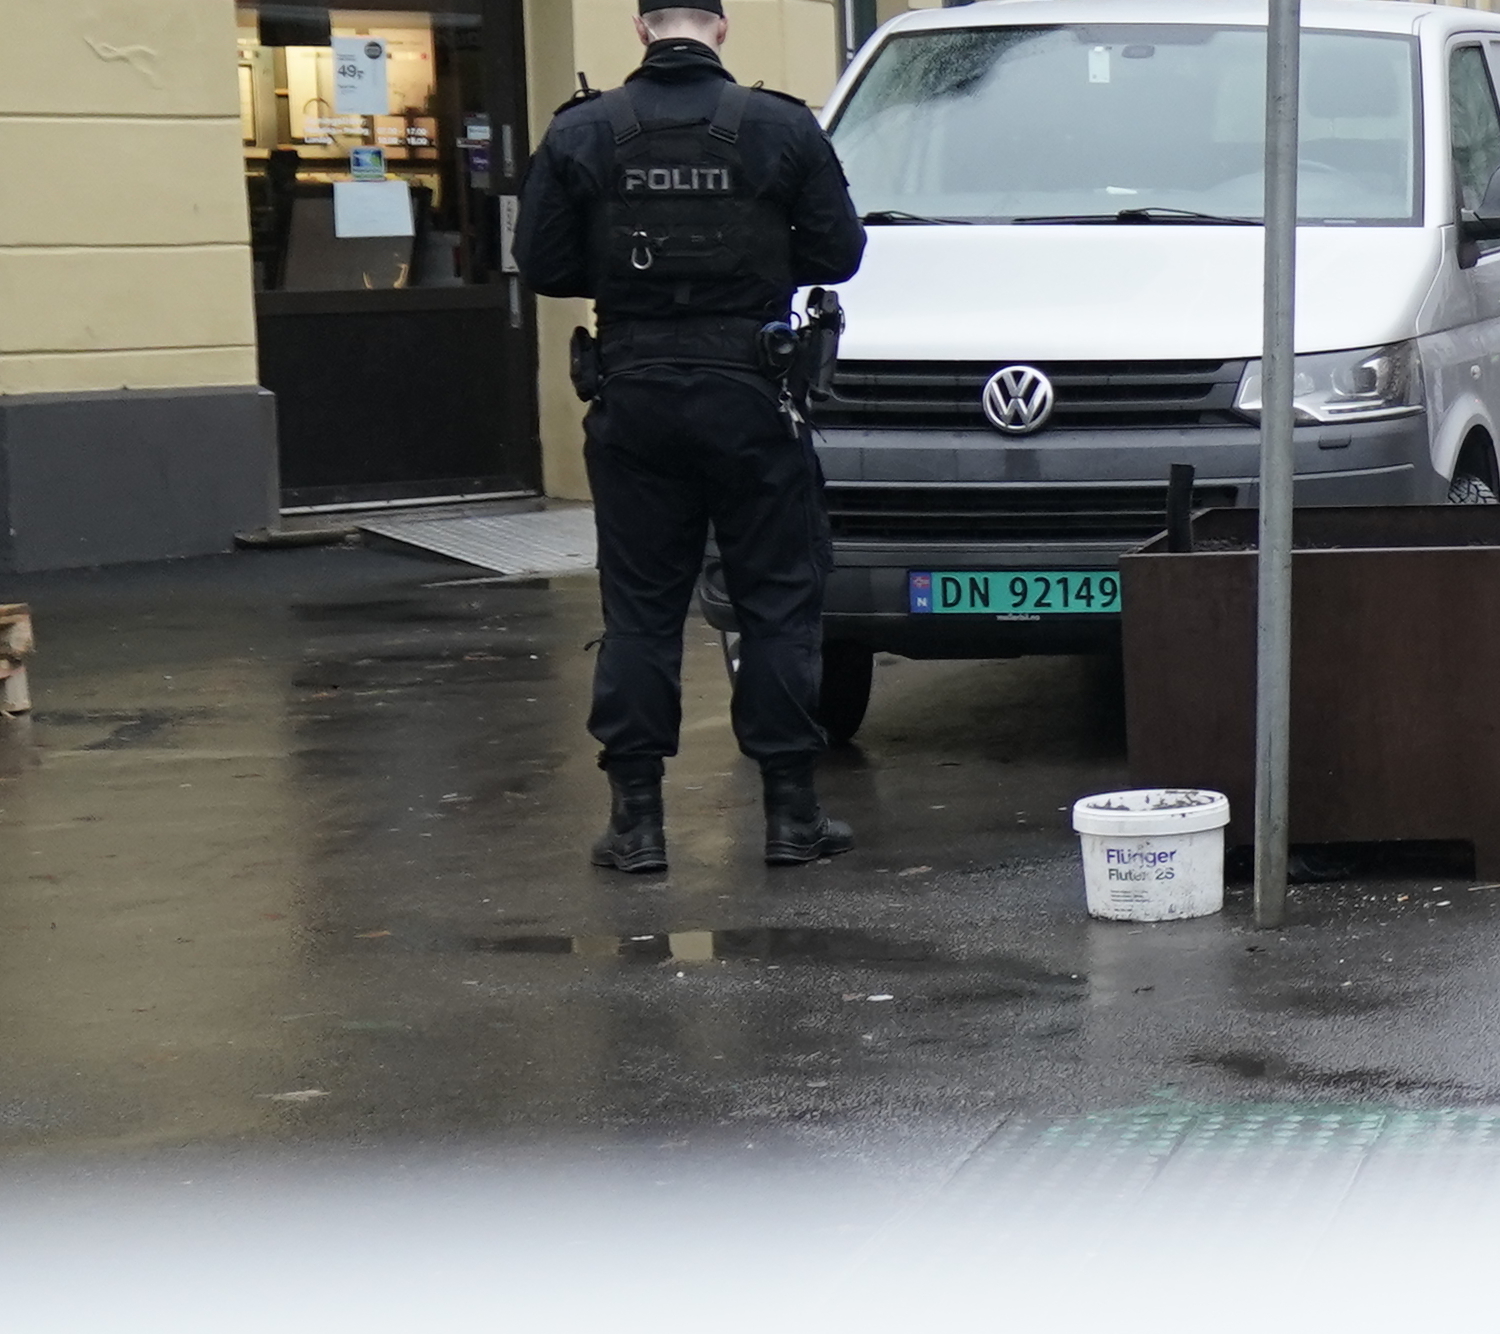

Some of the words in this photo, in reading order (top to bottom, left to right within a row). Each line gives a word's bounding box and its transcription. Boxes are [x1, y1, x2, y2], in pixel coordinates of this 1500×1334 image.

[625, 168, 729, 190] POLITI
[941, 577, 990, 608] DN
[1009, 576, 1118, 608] 92149
